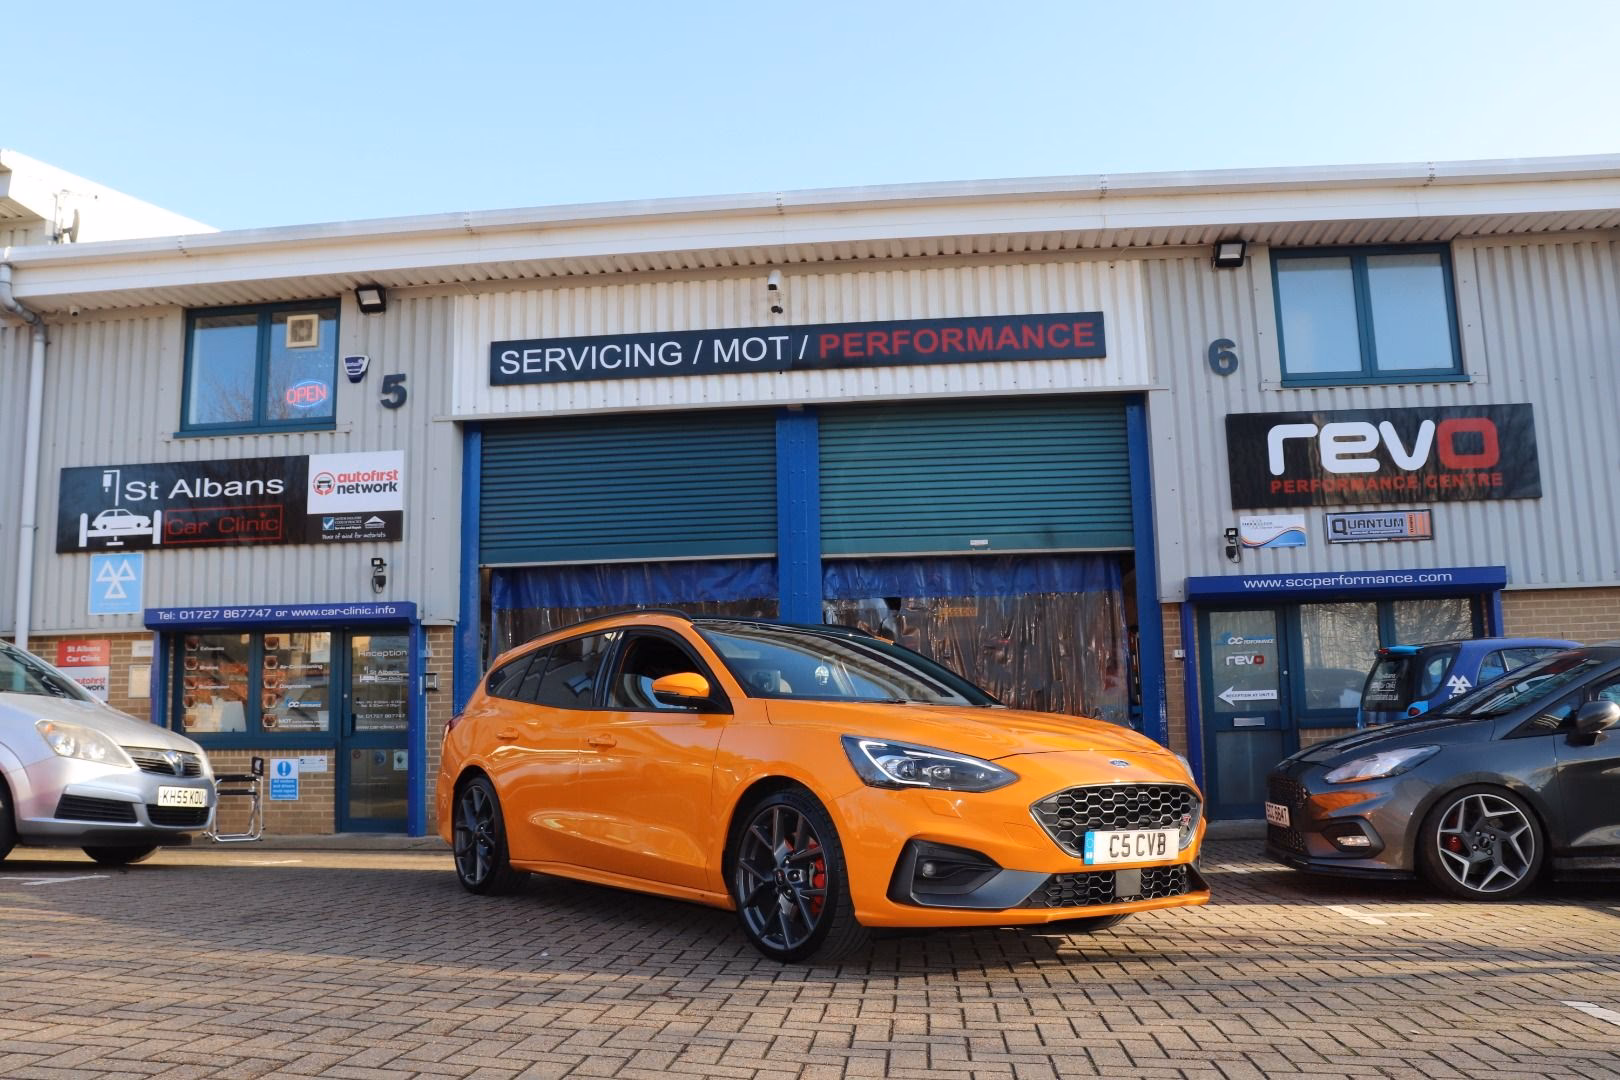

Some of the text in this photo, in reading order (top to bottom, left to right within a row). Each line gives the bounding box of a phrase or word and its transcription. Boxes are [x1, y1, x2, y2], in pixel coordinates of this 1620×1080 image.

[500, 322, 1095, 375] SERVICING / MOT / PERFORMANCE
[1207, 338, 1239, 376] 6
[286, 384, 328, 404] OPEN
[379, 373, 408, 409] 5
[1267, 417, 1500, 476] revo
[337, 469, 398, 483] autofirst
[1270, 472, 1503, 494] PERFORMANCE CENTRE
[124, 478, 284, 501] St Albans
[337, 481, 398, 494] network
[167, 512, 279, 535] Car Clinic
[1332, 517, 1404, 535] QUANTUM
[1243, 572, 1452, 589] www.sccperformance.com
[157, 605, 396, 620] Tel: 01727 867747 or www.car-clinic.info
[359, 649, 408, 657] Reception
[1225, 655, 1264, 666] revo
[1109, 832, 1166, 858] C5 CVB
